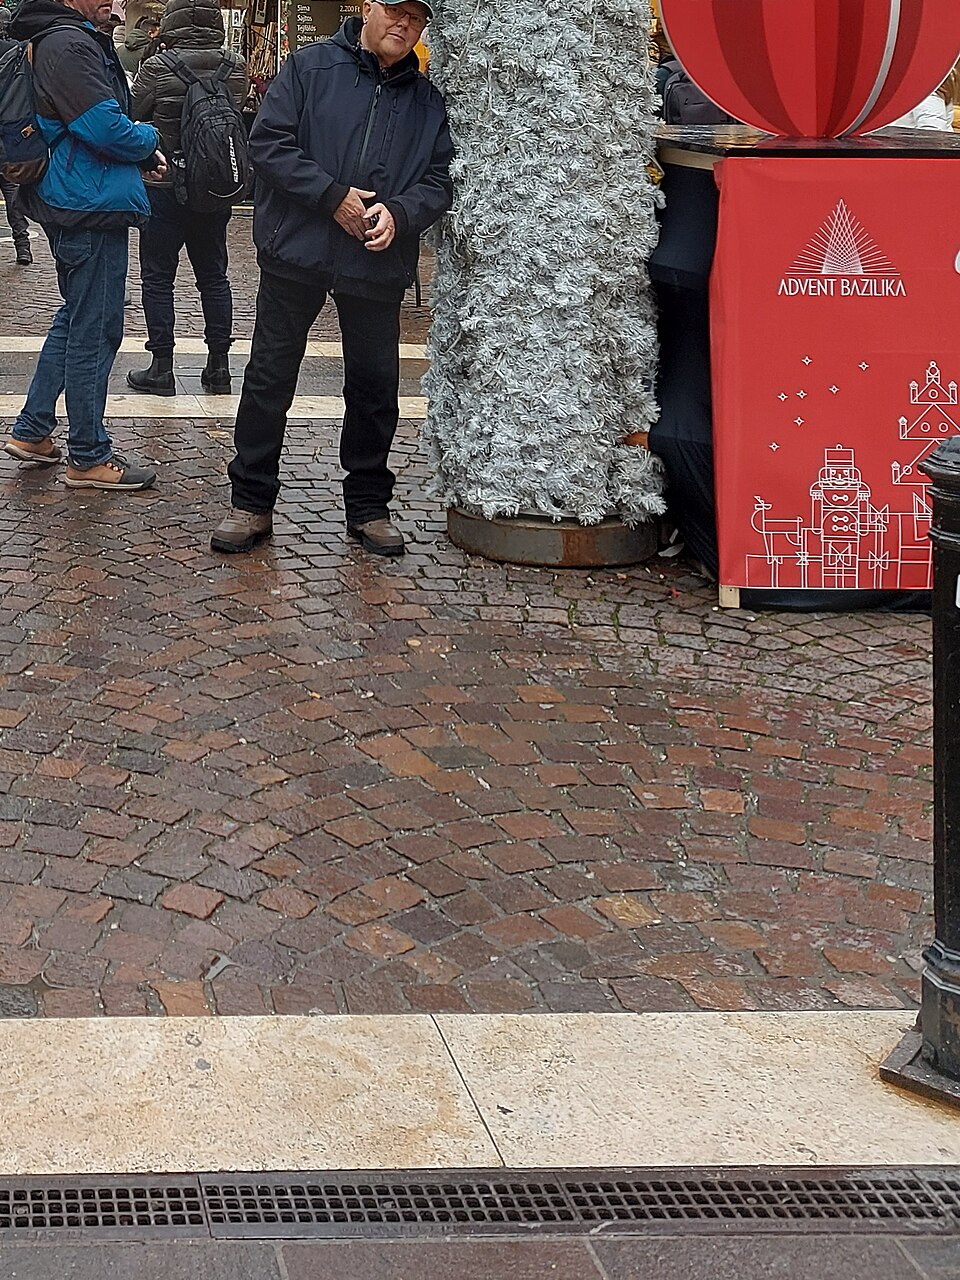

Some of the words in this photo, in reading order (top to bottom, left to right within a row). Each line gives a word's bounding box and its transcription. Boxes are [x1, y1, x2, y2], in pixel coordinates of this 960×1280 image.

[296, 4, 310, 12] Sima
[778, 278, 837, 296] ADVENT
[840, 278, 907, 297] BAZILIKA
